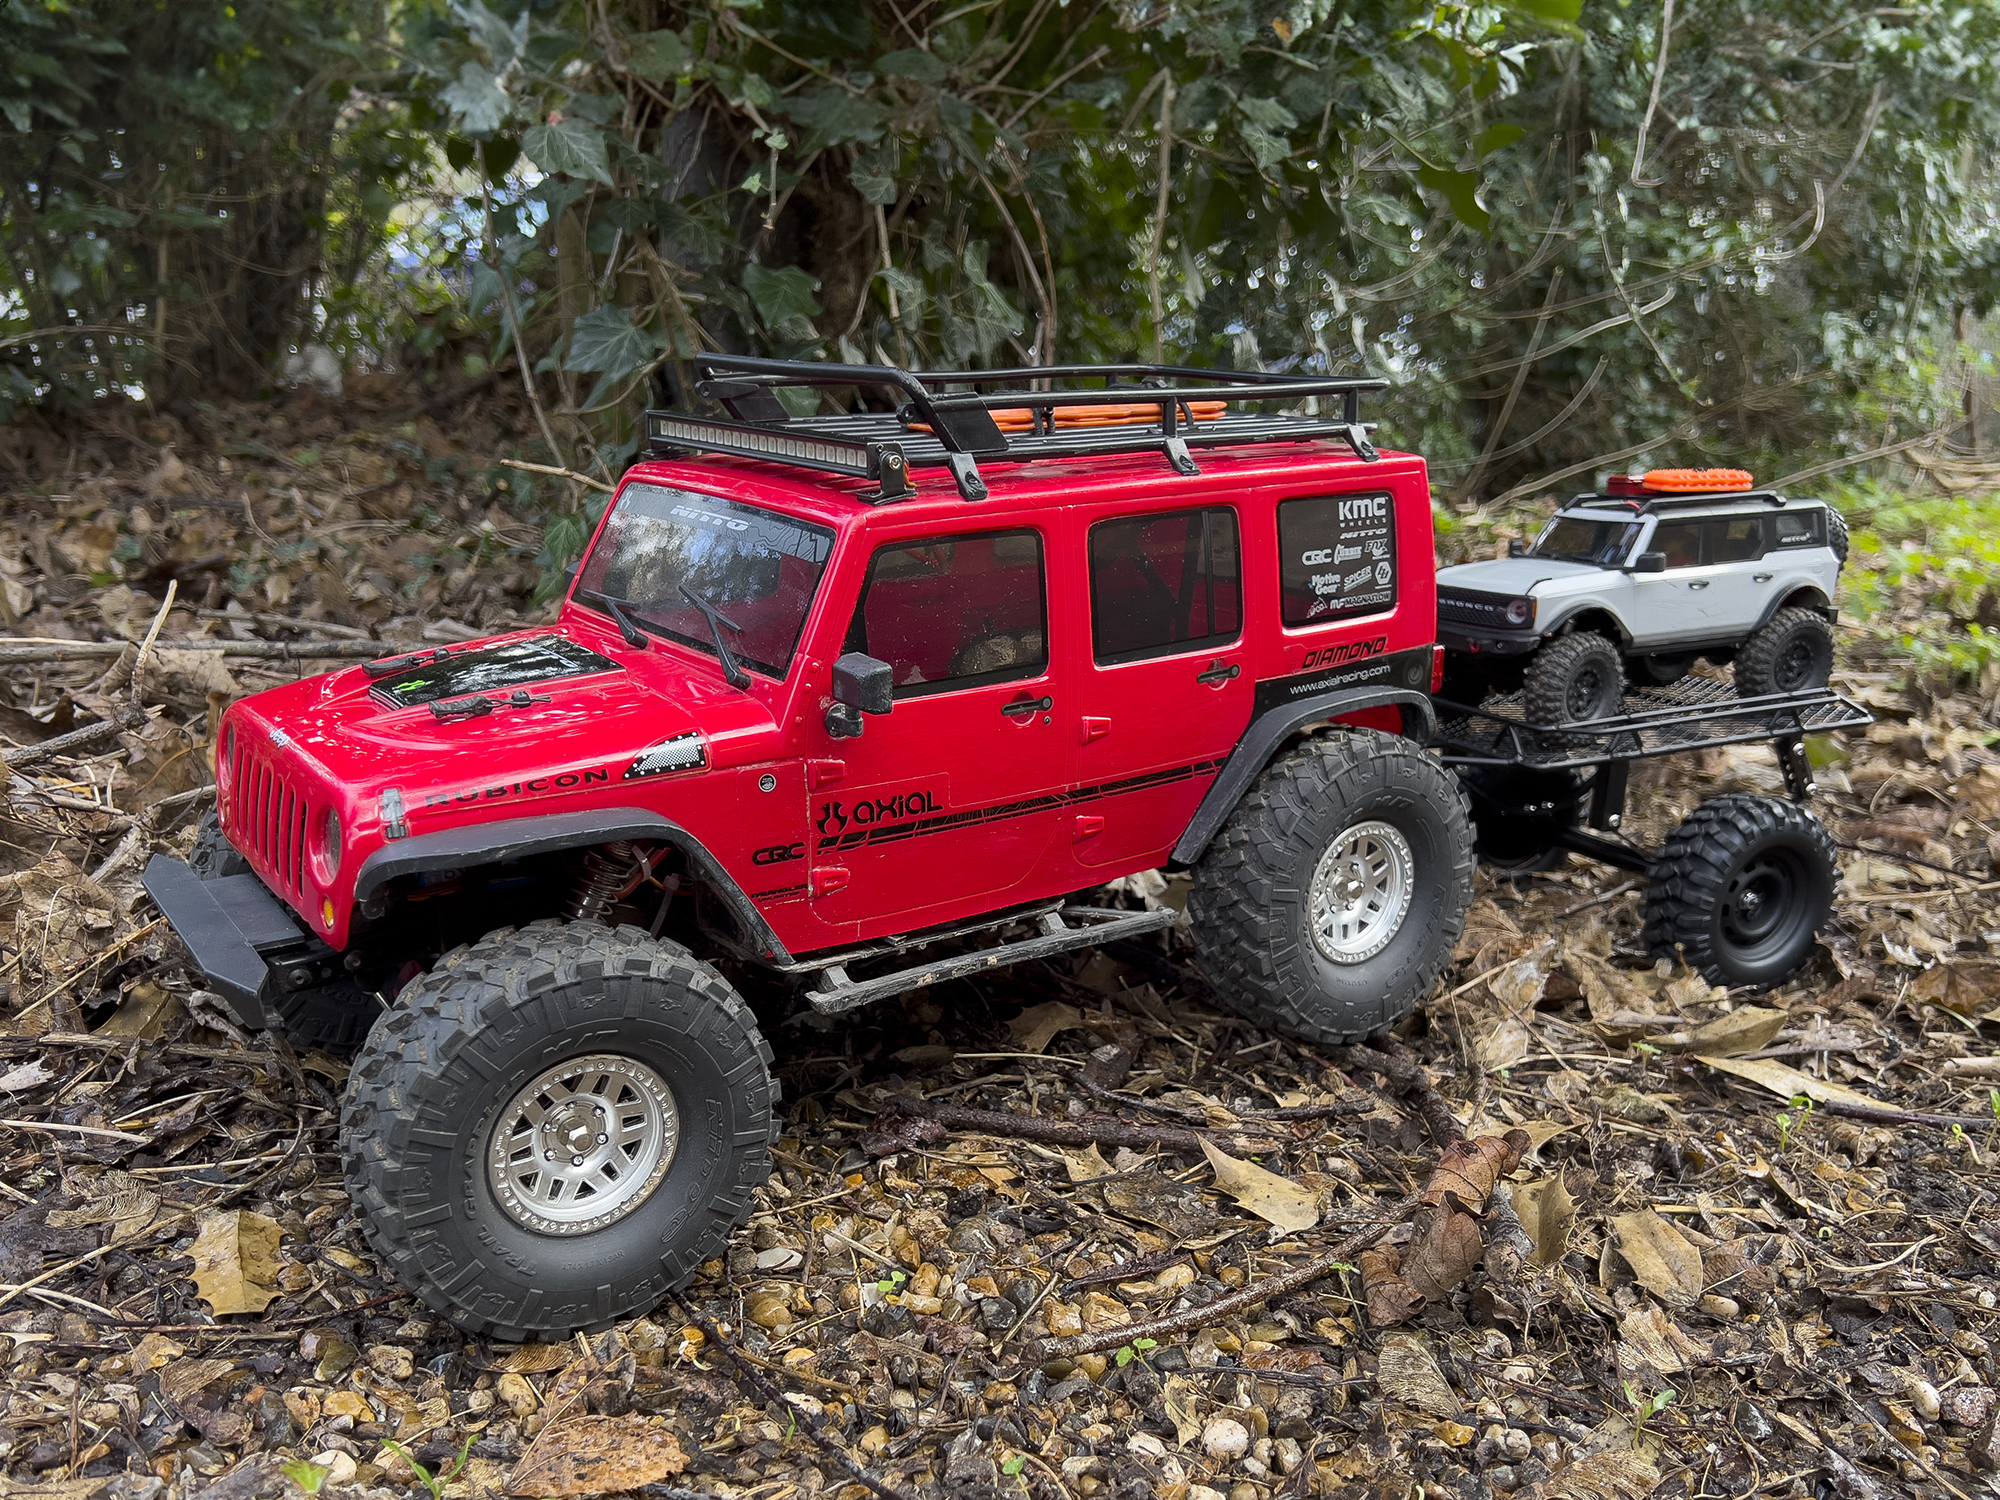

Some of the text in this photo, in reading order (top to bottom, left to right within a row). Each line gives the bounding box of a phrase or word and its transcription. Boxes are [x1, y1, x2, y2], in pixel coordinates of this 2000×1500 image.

[670, 504, 749, 531] NITTO
[1338, 497, 1386, 520] KMC
[1340, 517, 1387, 528] WHEELS
[1340, 528, 1387, 539] NITTO
[1302, 548, 1332, 566] CRC
[1311, 572, 1341, 586] Motive
[1343, 565, 1372, 585] SPICER
[1315, 583, 1338, 595] Gear
[1302, 636, 1387, 669] DIAMOND
[1289, 664, 1391, 695] www.axialracing.com
[425, 769, 609, 807] RUBICON
[752, 841, 806, 866] CRC
[478, 1224, 538, 1277] TRAIL
